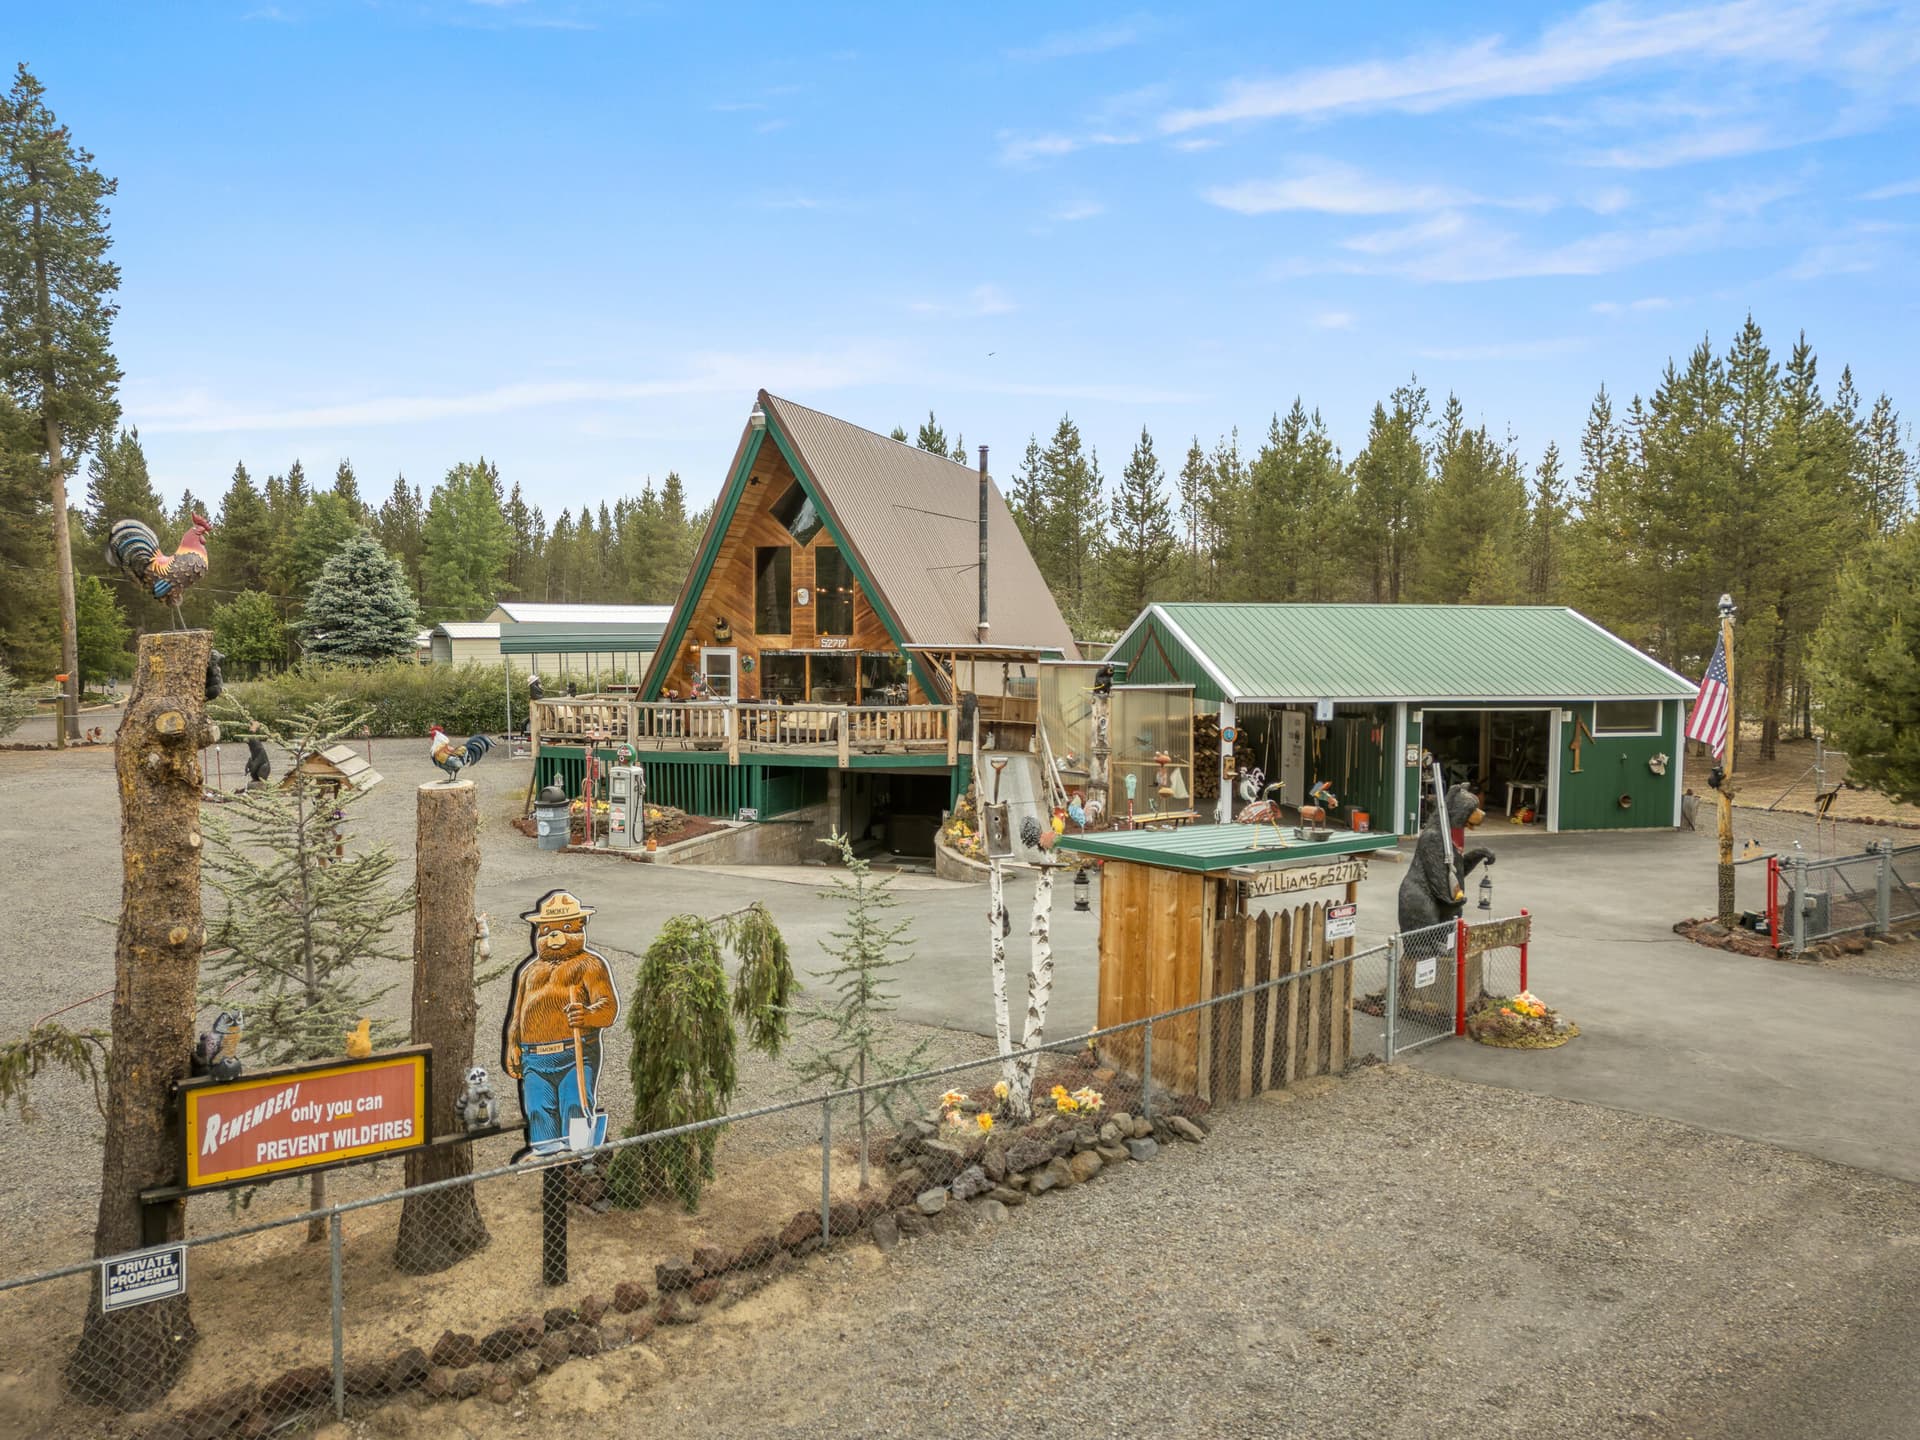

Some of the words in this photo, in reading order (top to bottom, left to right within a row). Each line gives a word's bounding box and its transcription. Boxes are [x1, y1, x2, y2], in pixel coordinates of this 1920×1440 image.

[201, 1083, 300, 1156] REMEMBER!
[291, 1101, 322, 1124] only
[326, 1100, 352, 1122] you
[357, 1095, 382, 1112] can
[257, 1133, 329, 1162] PREVENT
[333, 1119, 412, 1148] WILDFIRES
[110, 1263, 178, 1289] PROPERTY
[117, 1254, 172, 1275] PRIVATE
